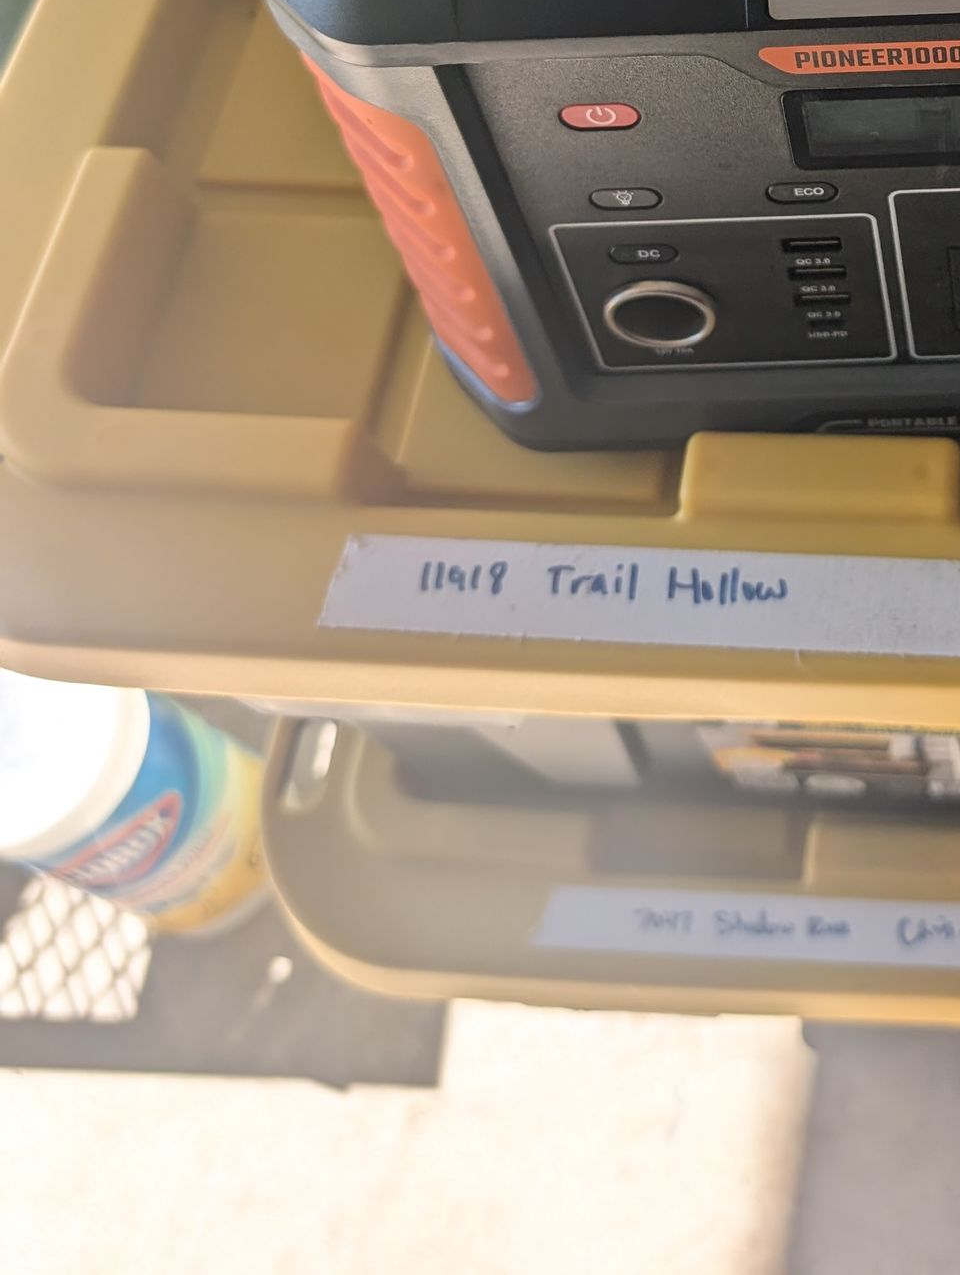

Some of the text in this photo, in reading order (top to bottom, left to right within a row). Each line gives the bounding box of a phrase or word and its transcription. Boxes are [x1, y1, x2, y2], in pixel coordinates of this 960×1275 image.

[793, 186, 825, 198] ECO
[637, 249, 661, 260] DC
[795, 257, 832, 266] QC 3.0
[800, 284, 837, 293] QC 3.0
[868, 416, 958, 428] PORTABLE
[547, 561, 640, 602] Trail
[666, 566, 789, 607] Hollow
